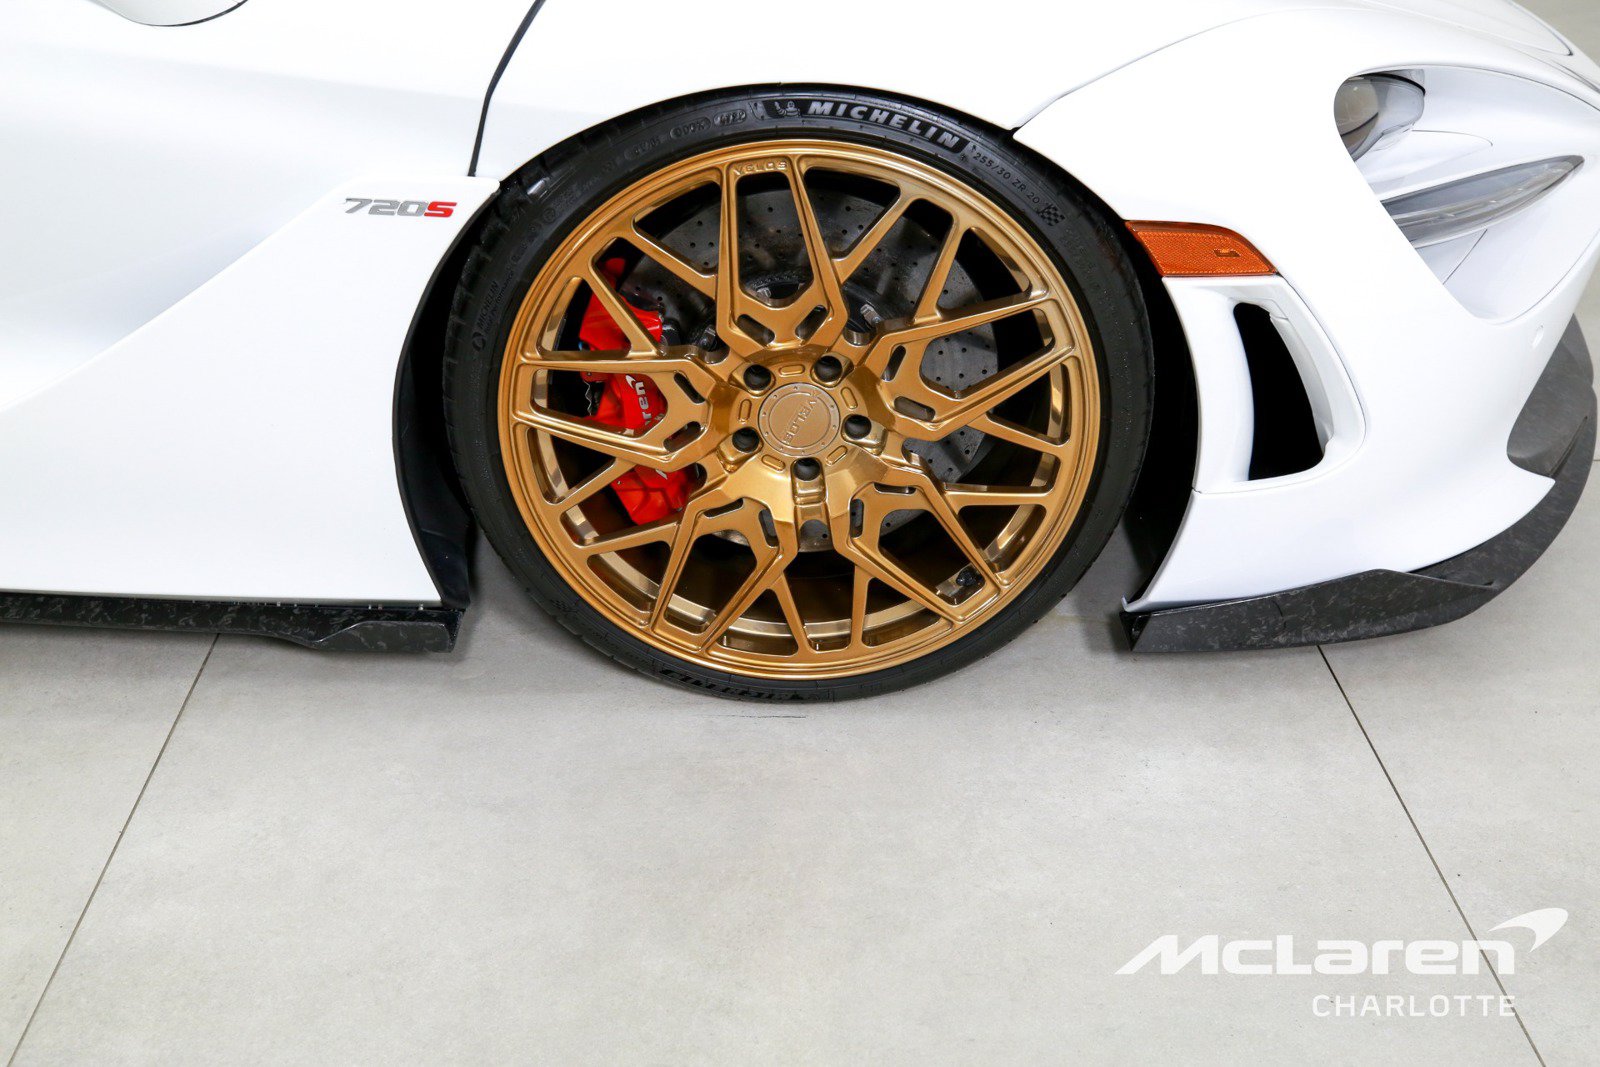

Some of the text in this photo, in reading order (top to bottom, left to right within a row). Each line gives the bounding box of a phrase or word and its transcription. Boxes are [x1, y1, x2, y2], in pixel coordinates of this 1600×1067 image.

[807, 100, 960, 148] MICHELIN
[972, 152, 1041, 205] 255/30 ZR 20
[344, 198, 458, 218] 720S
[635, 381, 653, 425] ren
